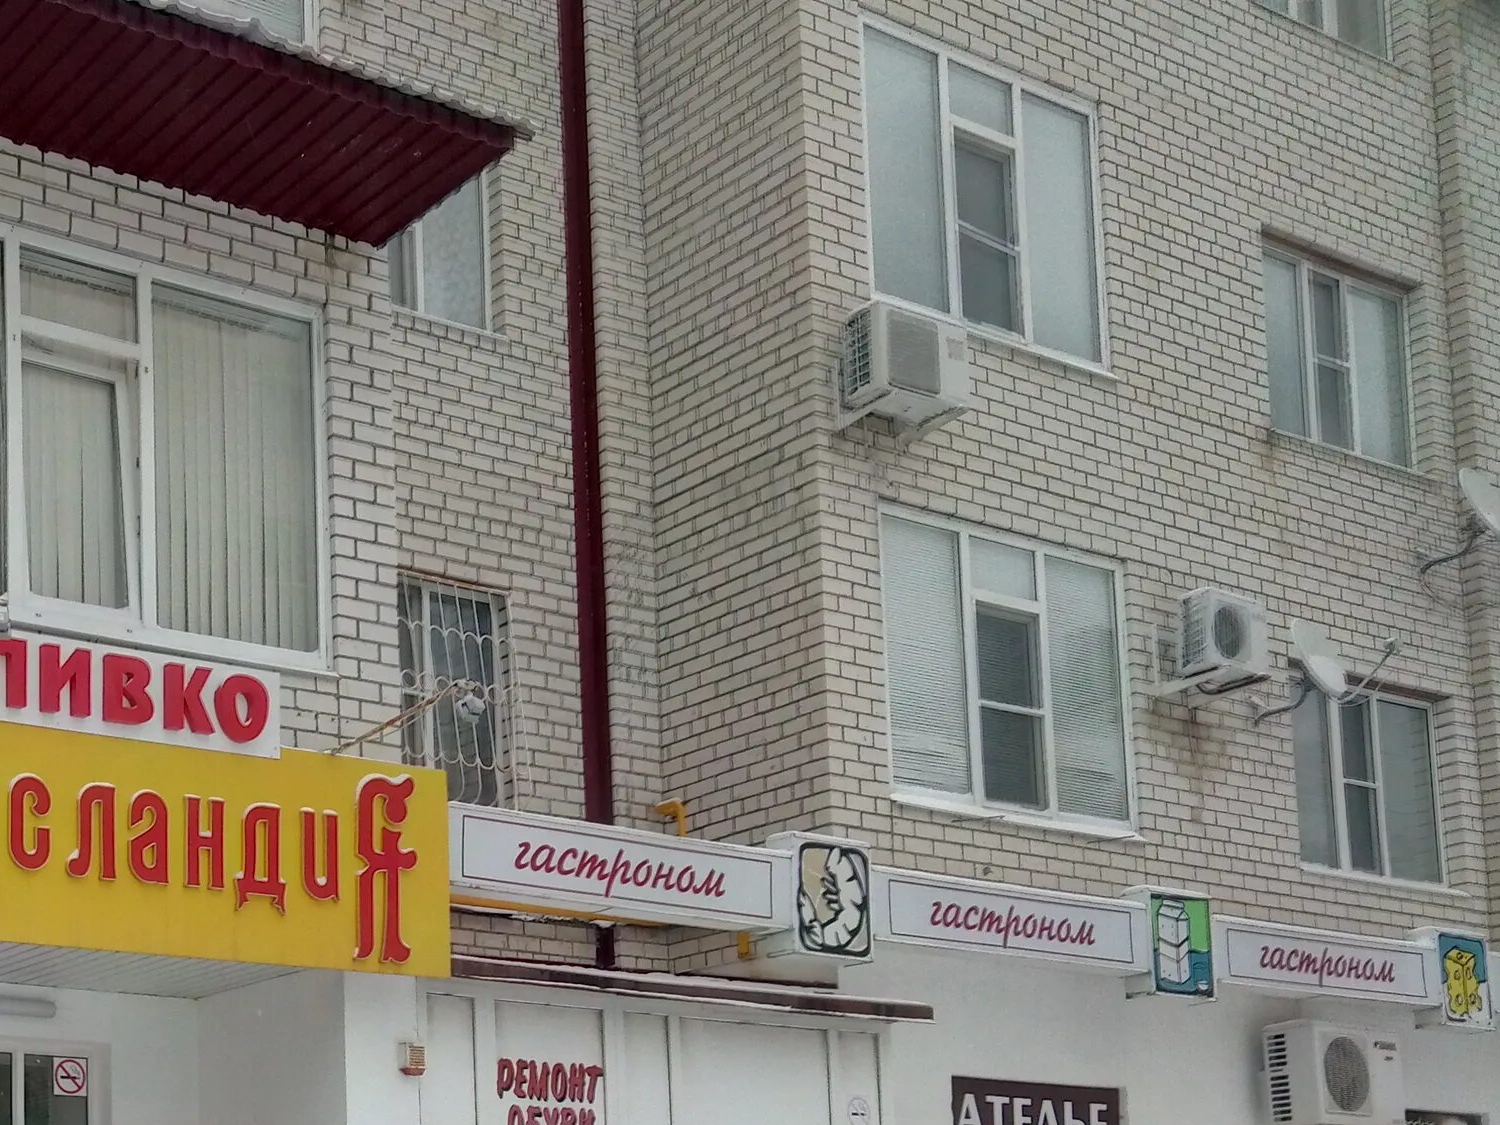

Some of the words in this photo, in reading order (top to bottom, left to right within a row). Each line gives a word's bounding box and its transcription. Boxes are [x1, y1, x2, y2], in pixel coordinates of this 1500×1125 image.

[513, 840, 727, 898] гастроном
[928, 899, 1096, 949] гастроном
[1258, 942, 1397, 987] гастроном
[496, 1057, 604, 1104] РЕМОНТ
